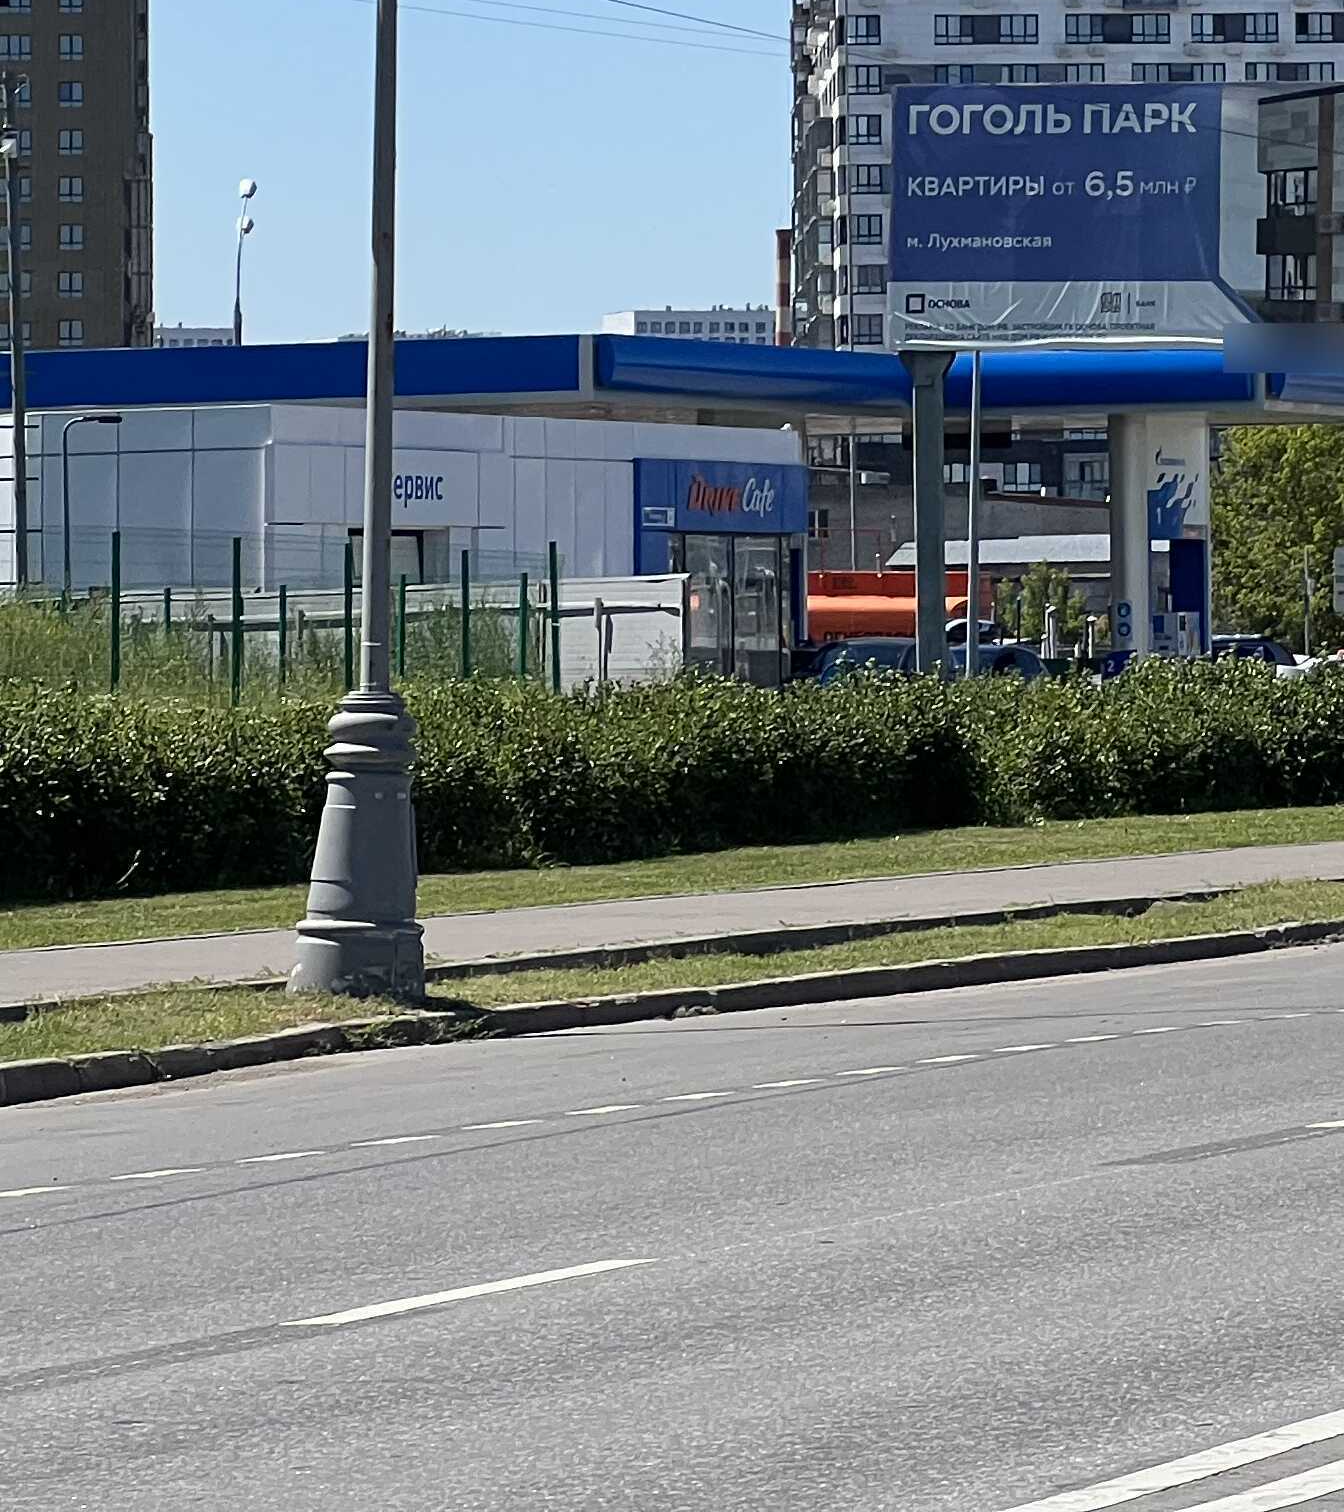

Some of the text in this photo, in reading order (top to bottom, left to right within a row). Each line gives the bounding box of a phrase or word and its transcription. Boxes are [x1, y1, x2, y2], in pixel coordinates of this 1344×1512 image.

[908, 102, 1198, 135] ГОГОЛЬ ПАРК
[907, 175, 1045, 197] КВАРТИРЫ
[1084, 170, 1134, 200] 6,5
[927, 233, 1052, 251] Лухмановская
[928, 299, 971, 309] ОСНОВА
[393, 474, 443, 508] ервис
[742, 478, 775, 518] Cafe
